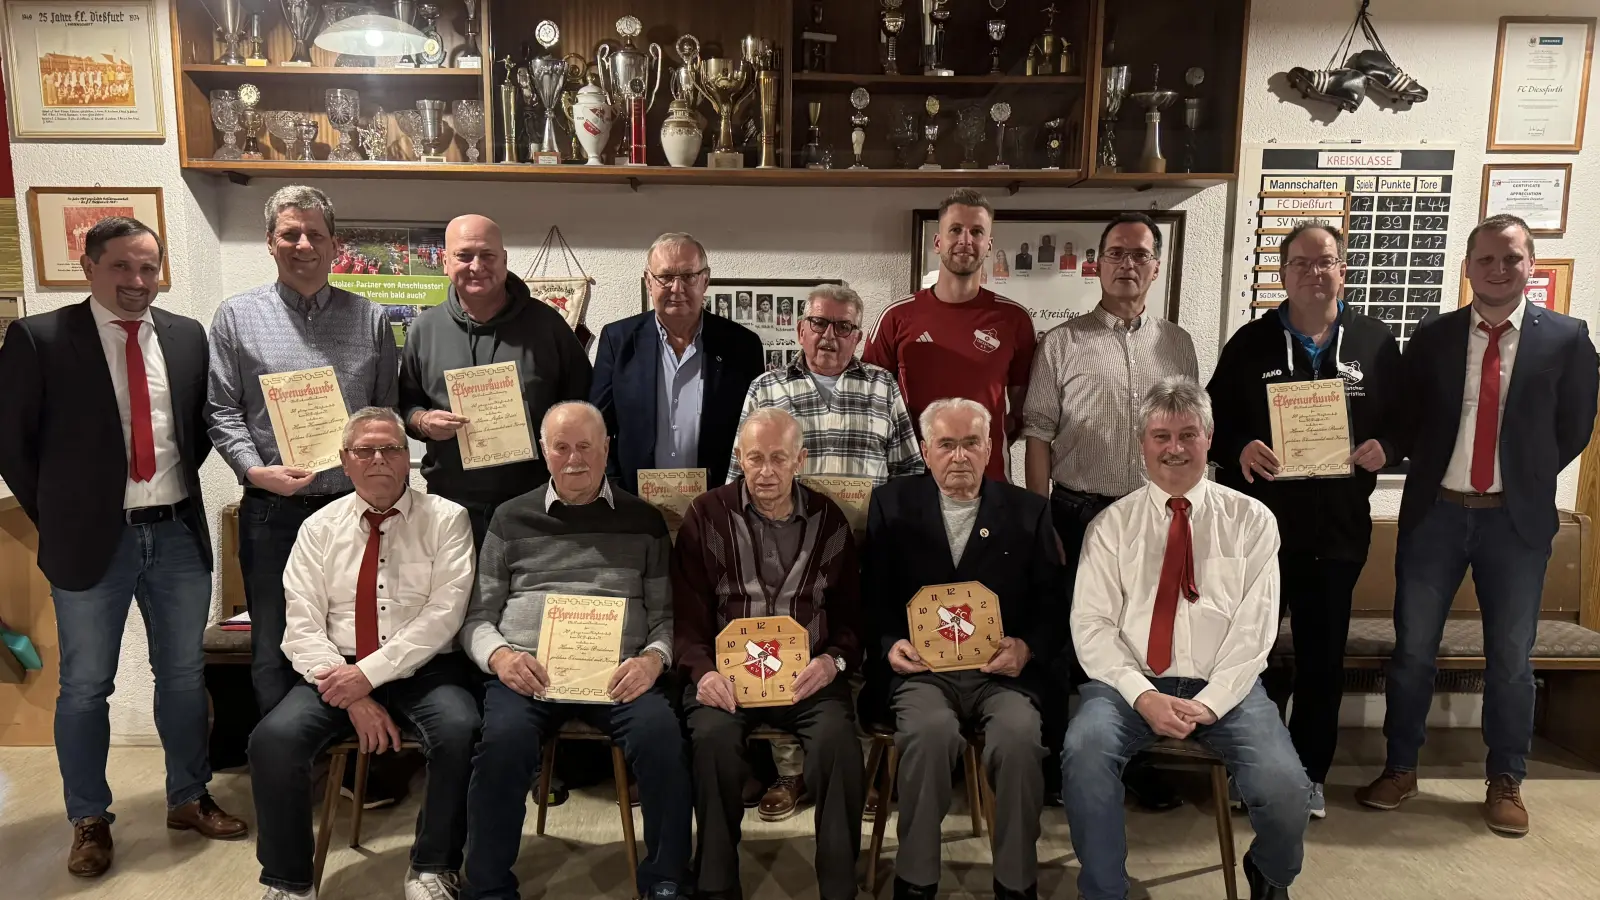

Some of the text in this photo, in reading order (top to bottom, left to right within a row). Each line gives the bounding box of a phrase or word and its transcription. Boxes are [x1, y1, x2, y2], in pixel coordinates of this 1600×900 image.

[38, 12, 48, 22] 25
[51, 12, 72, 23] Jahre
[90, 12, 124, 23] Dießfurt
[1326, 156, 1392, 166] KREISKLASSE
[1270, 180, 1438, 190] Mannschaften Spiele Punkte Tore
[1277, 200, 1290, 208] FC
[1292, 199, 1332, 208] Dießfurt
[1352, 197, 1372, 211] 17
[1386, 198, 1411, 212] 47
[1277, 218, 1289, 226] SV
[1352, 216, 1370, 230] 17
[1382, 216, 1402, 229] 39
[1266, 236, 1278, 245] SV
[1350, 235, 1368, 248] 17
[1380, 236, 1400, 249] 31
[1348, 253, 1367, 266] 17
[1377, 252, 1397, 266] 31
[1349, 271, 1366, 283] 17
[1378, 271, 1398, 284] 29
[1346, 289, 1365, 302] 17
[1376, 290, 1397, 302] 26
[1040, 308, 1080, 320] Kreisliga
[1377, 307, 1396, 320] 26
[1262, 369, 1282, 379] JAKO
[548, 605, 619, 622] Ehrenurkunde
[955, 608, 967, 619] FC
[763, 643, 775, 654] FC
